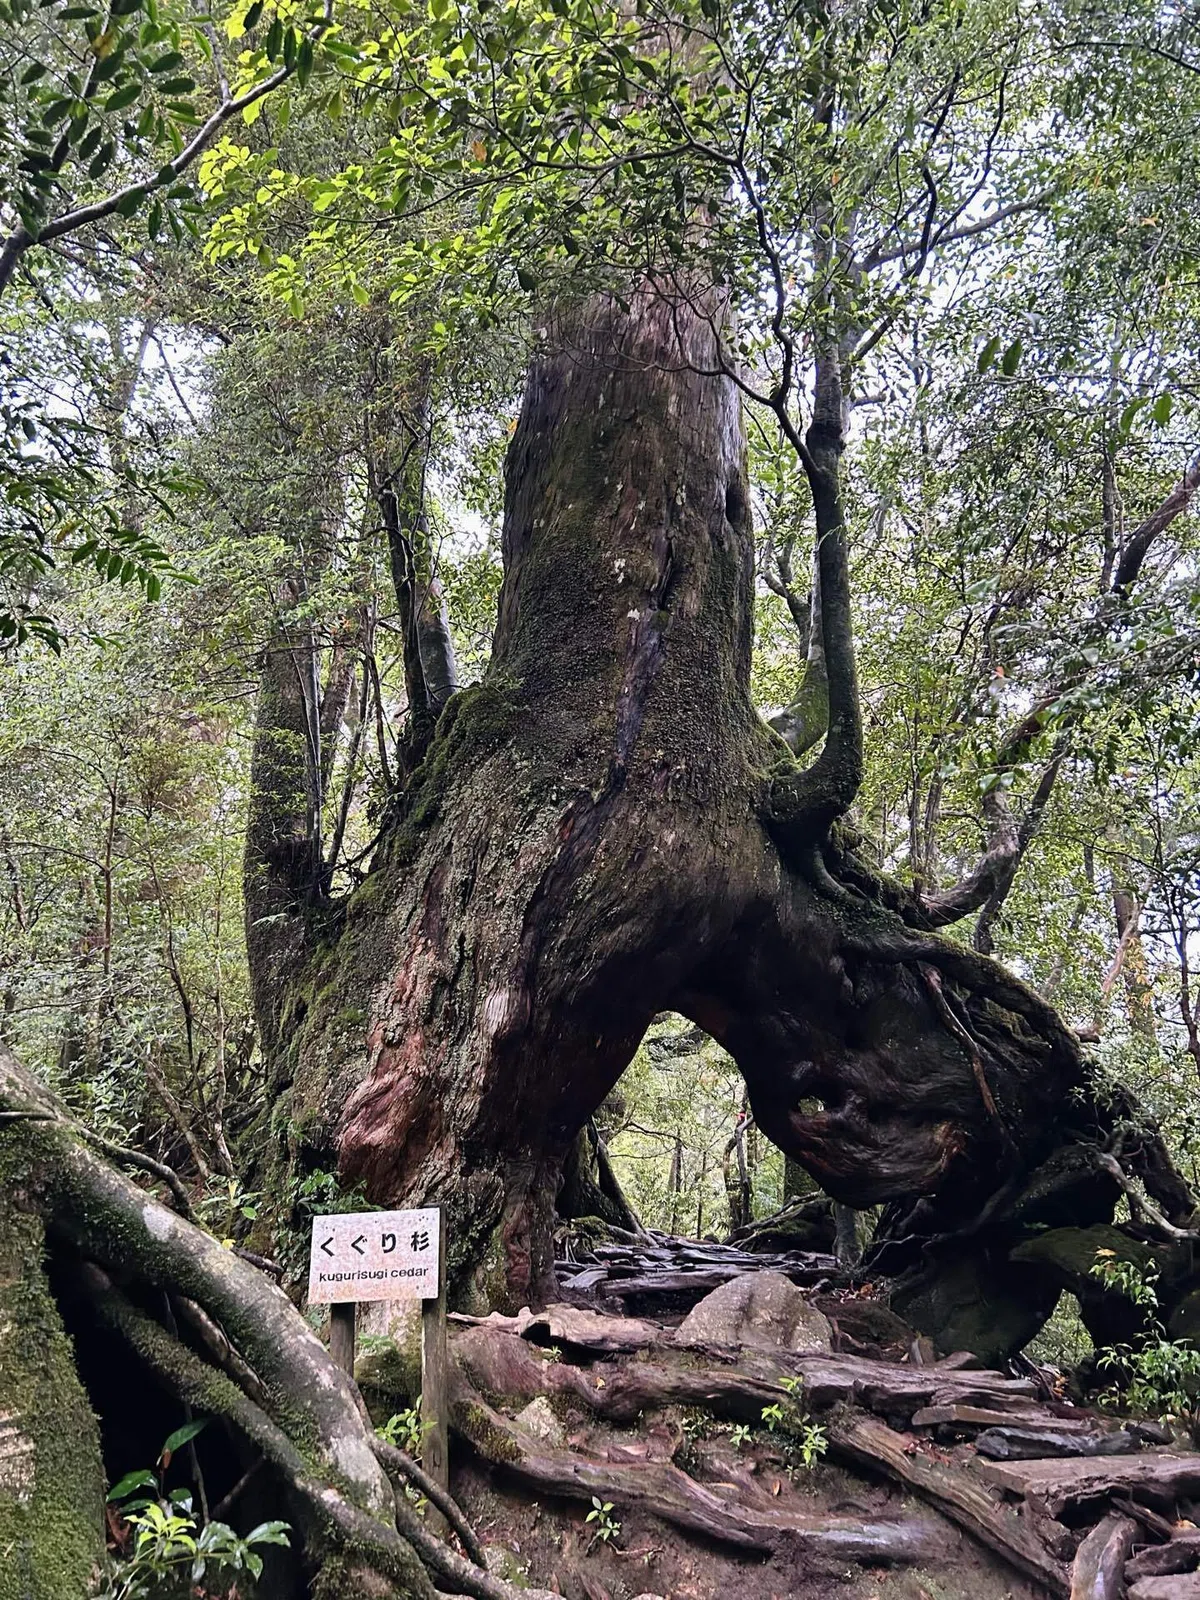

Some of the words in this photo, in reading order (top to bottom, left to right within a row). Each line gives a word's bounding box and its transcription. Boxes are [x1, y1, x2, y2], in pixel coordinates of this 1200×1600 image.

[320, 1231, 430, 1257] くぐり杉
[319, 1269, 388, 1282] kugurisugi
[391, 1267, 429, 1278] cedar
